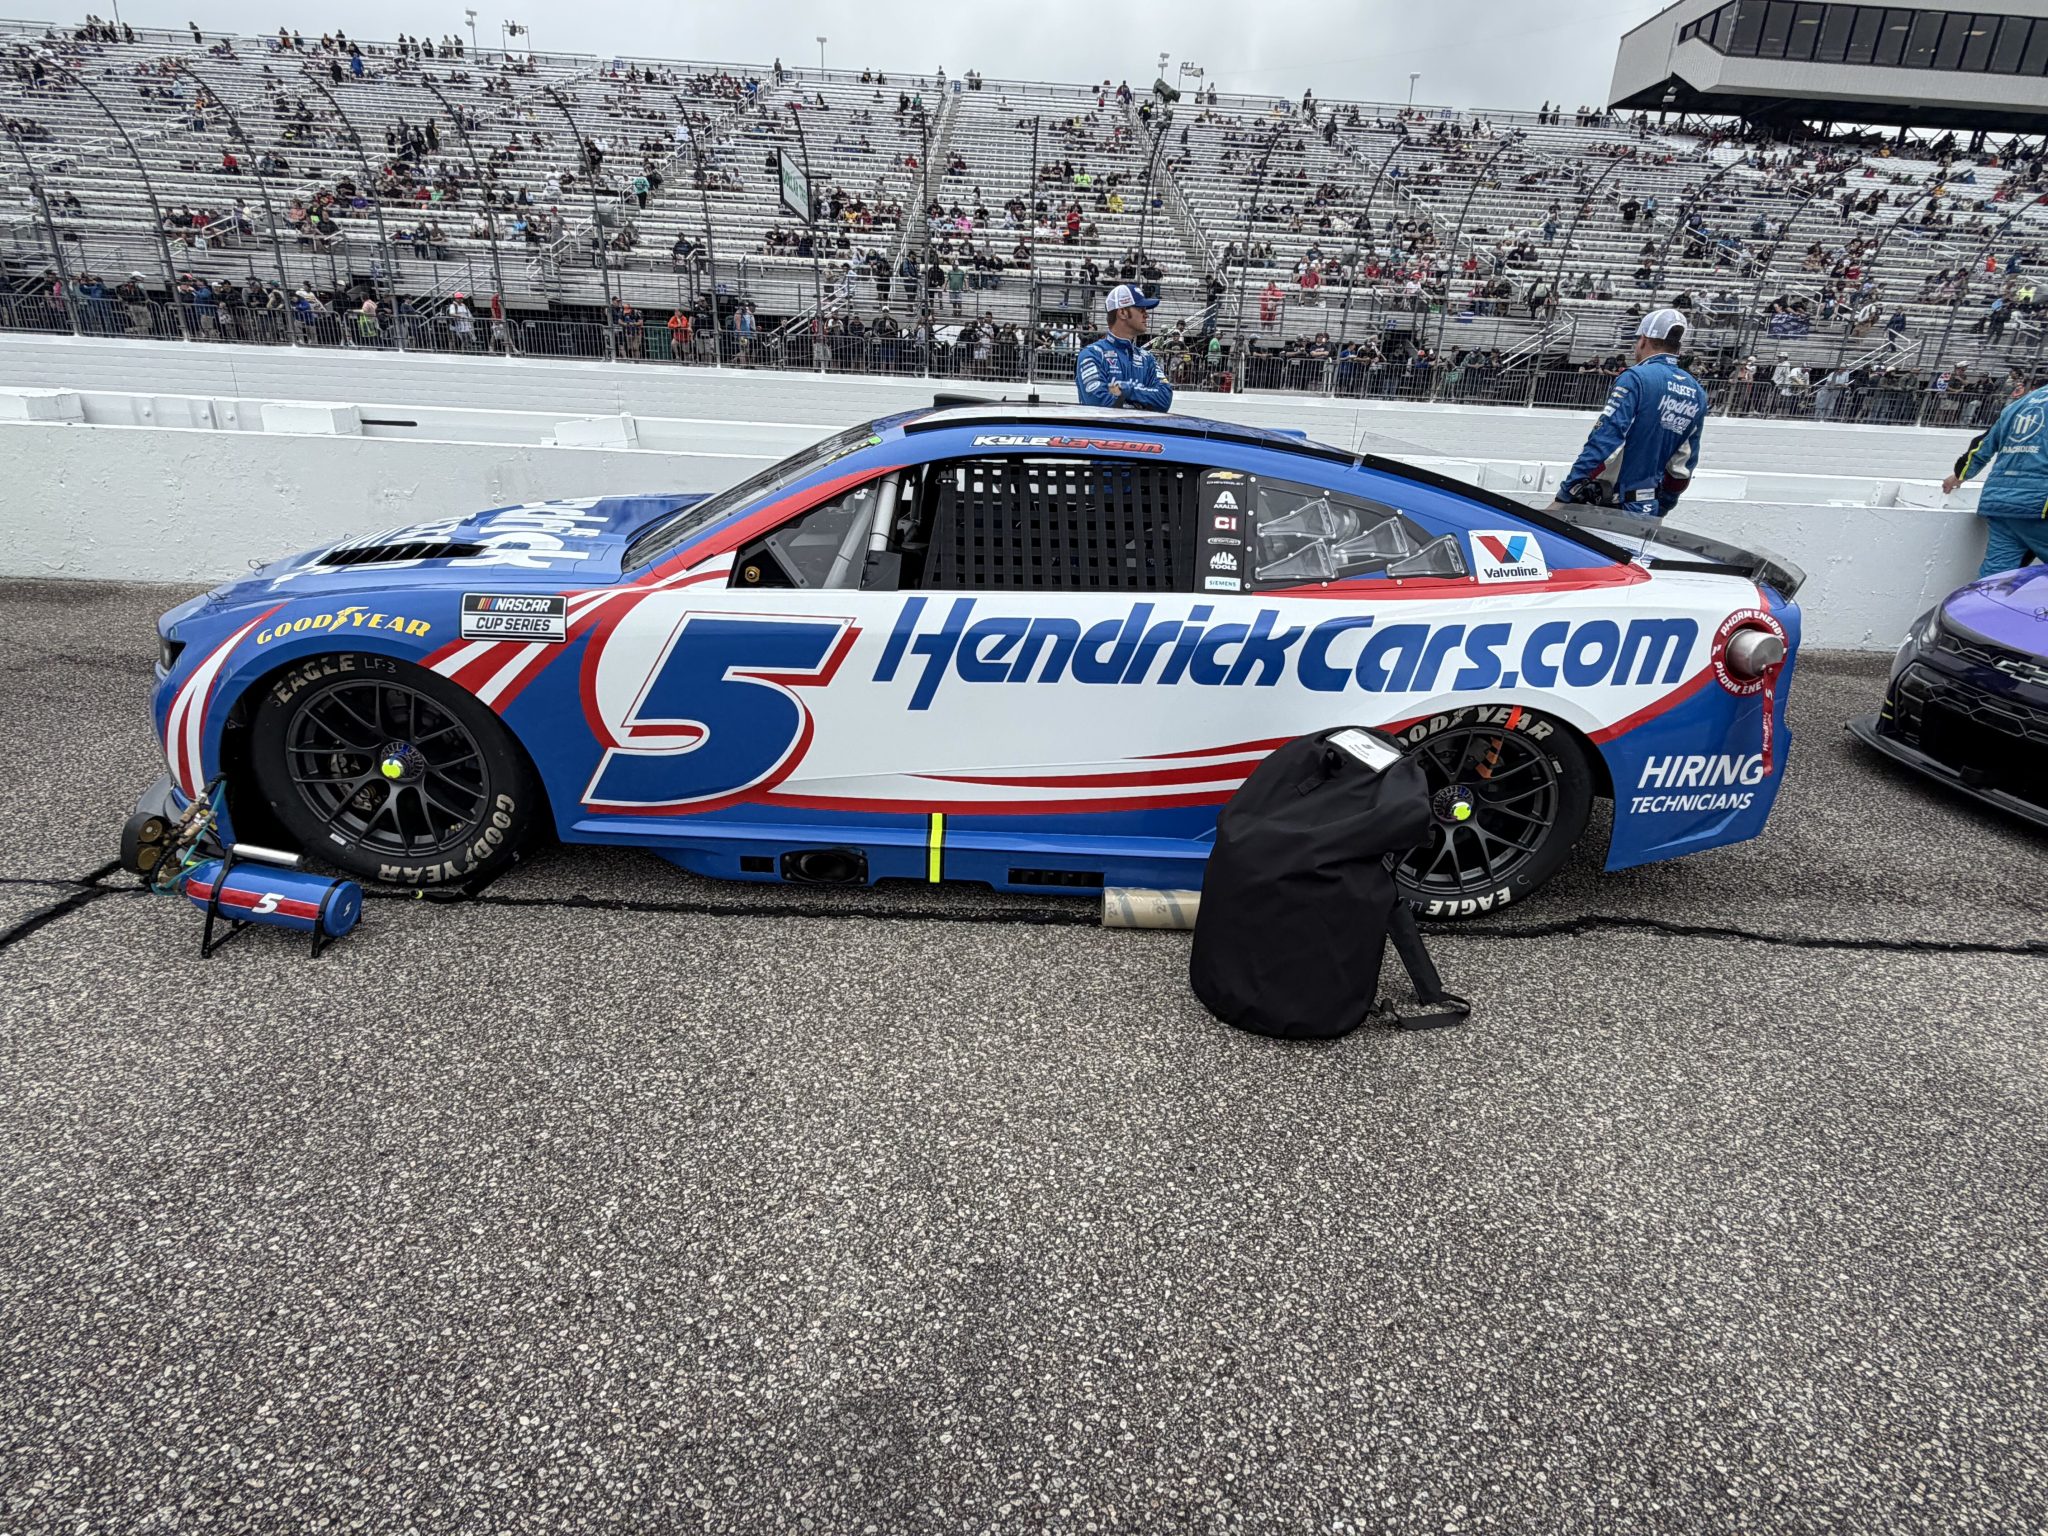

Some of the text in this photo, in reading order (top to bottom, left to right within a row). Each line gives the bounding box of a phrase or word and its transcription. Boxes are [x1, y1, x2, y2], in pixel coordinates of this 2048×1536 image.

[1657, 394, 1700, 419] Hedrick
[1214, 516, 1237, 530] CI
[1210, 551, 1238, 566] MAC
[1209, 580, 1237, 588] SIEMENS
[1484, 567, 1539, 578] Valvoline
[494, 597, 551, 612] NASCAR
[476, 617, 551, 632] CUP SERIES
[1720, 610, 1786, 641] PHORM ENERGY
[872, 596, 1699, 711] HendrickCars.com
[280, 653, 356, 704] EAGLE
[1714, 661, 1764, 695] PHORM ENE
[580, 611, 861, 812] 5
[1399, 705, 1555, 748] ODYEAR
[1637, 753, 1765, 789] HIRING
[1629, 792, 1755, 814] TECHNICIANS
[251, 892, 286, 914] 5
[1425, 886, 1511, 916] EAGLE
